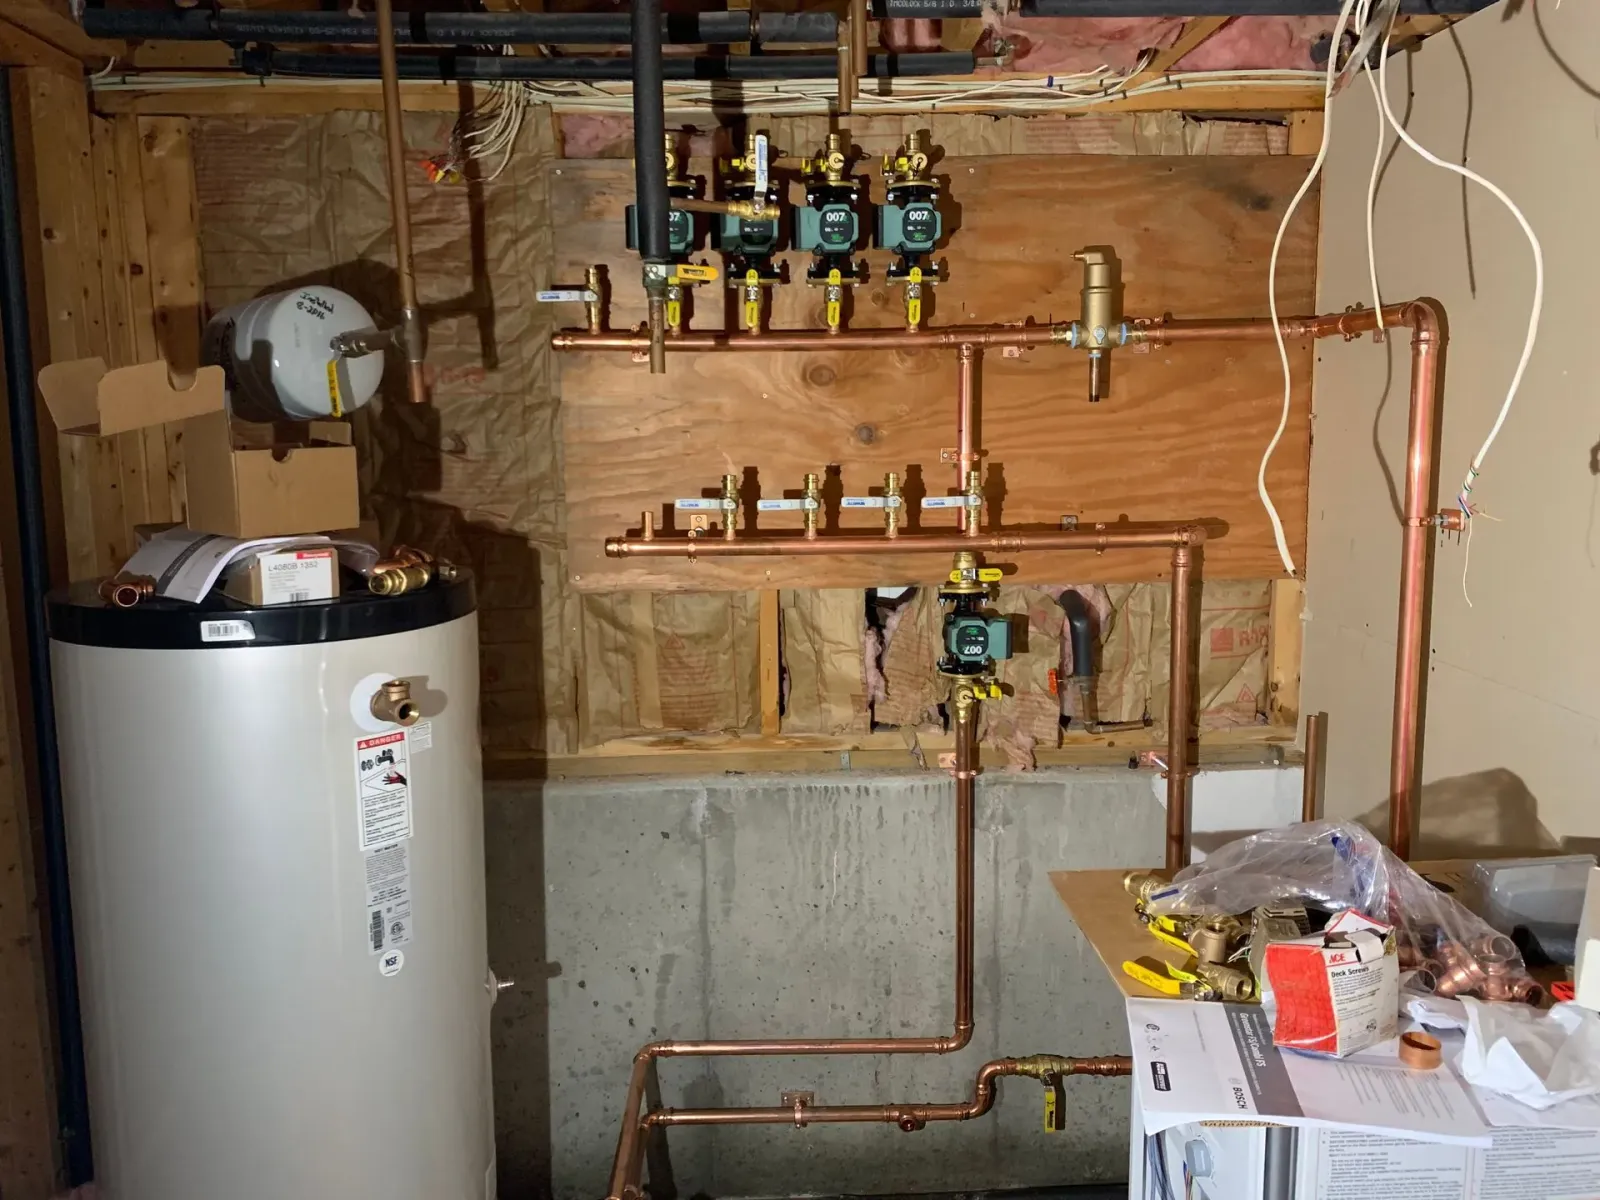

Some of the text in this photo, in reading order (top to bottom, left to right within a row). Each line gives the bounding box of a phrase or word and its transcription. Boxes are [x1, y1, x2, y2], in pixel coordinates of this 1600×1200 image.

[369, 734, 401, 746] DANGER
[385, 956, 398, 967] NSF
[1329, 953, 1346, 964] ACE
[1331, 966, 1370, 978] Deck Screws
[1232, 1087, 1248, 1110] BOSCH
